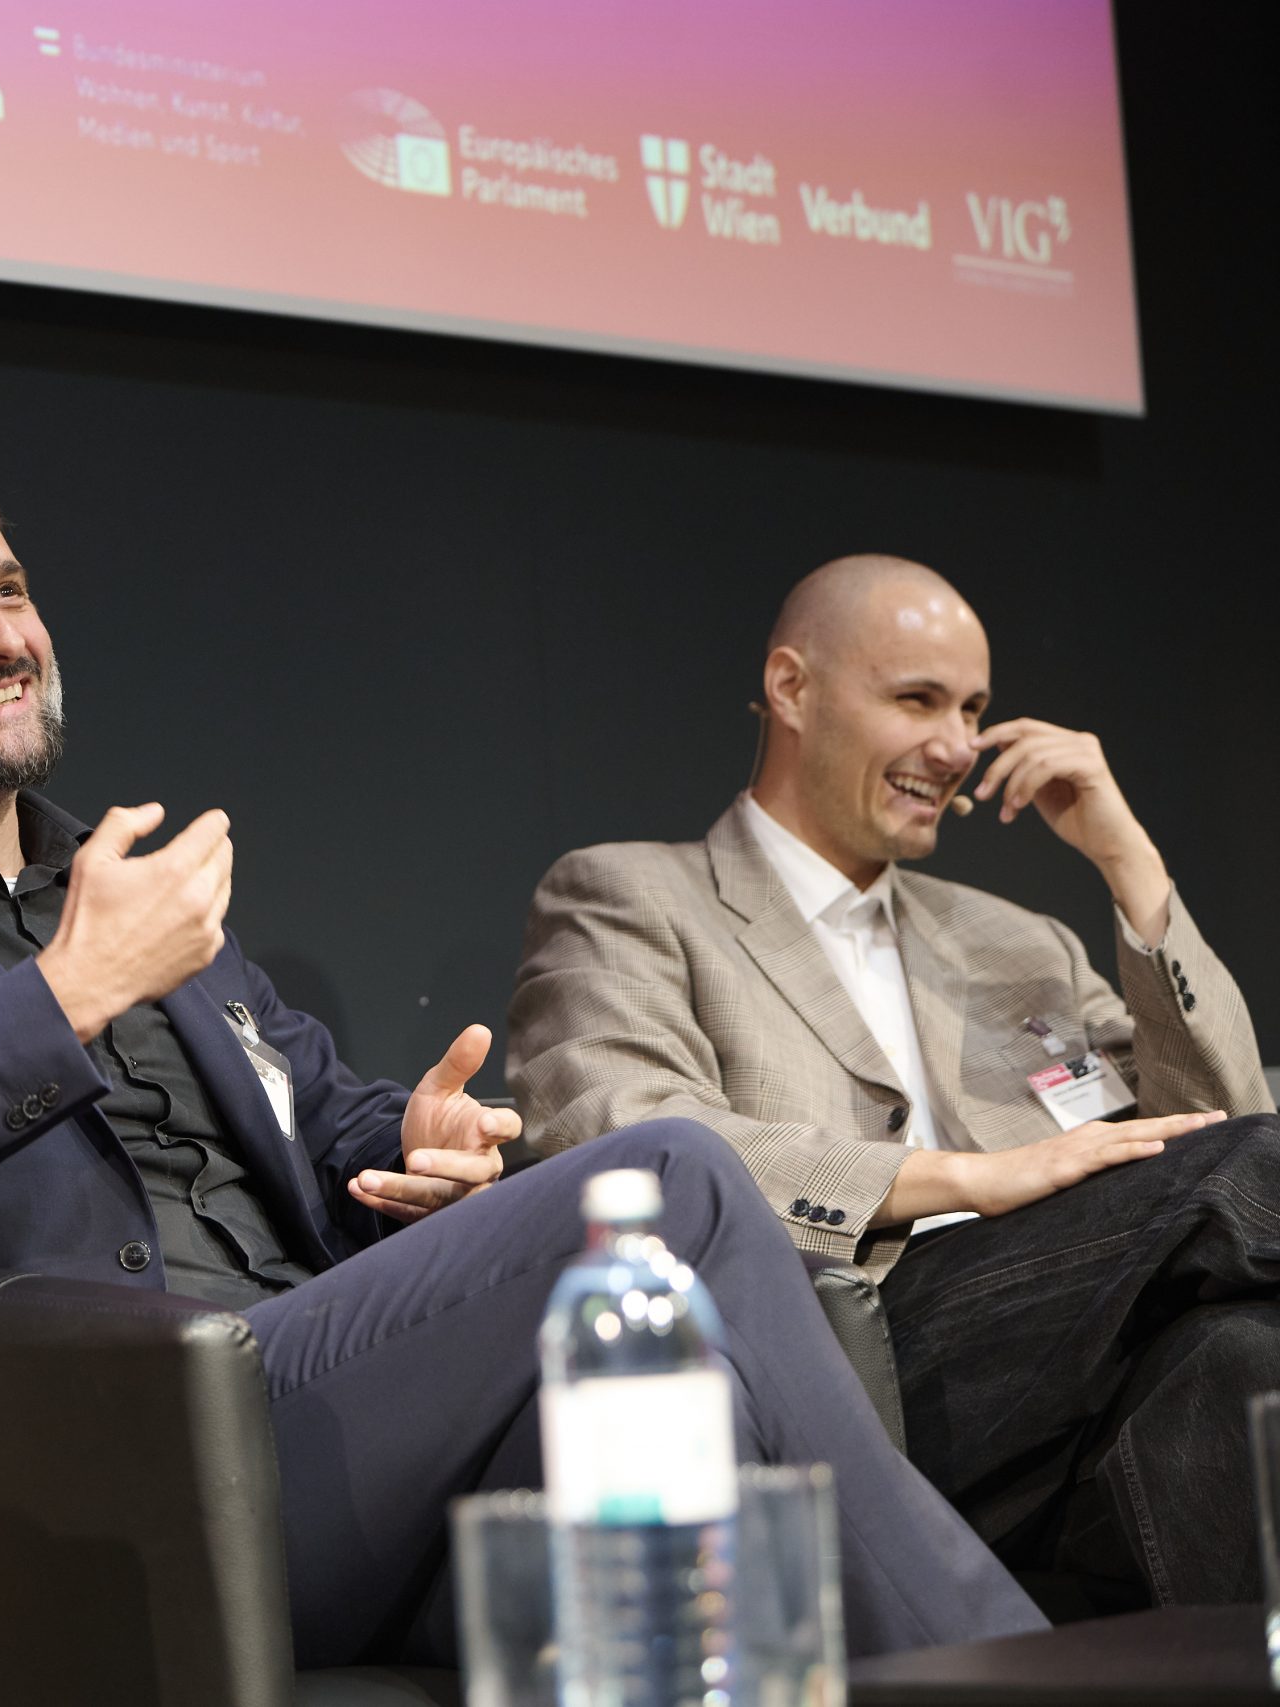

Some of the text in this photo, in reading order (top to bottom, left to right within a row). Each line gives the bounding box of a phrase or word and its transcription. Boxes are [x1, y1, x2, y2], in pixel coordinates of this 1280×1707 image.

[205, 134, 263, 168] Sport
[458, 124, 619, 182] Europäisches
[699, 144, 776, 198] Stadt
[462, 166, 589, 219] Parlament
[701, 192, 780, 247] Wien
[799, 183, 932, 251] Verbund
[966, 191, 1052, 265] VIG
